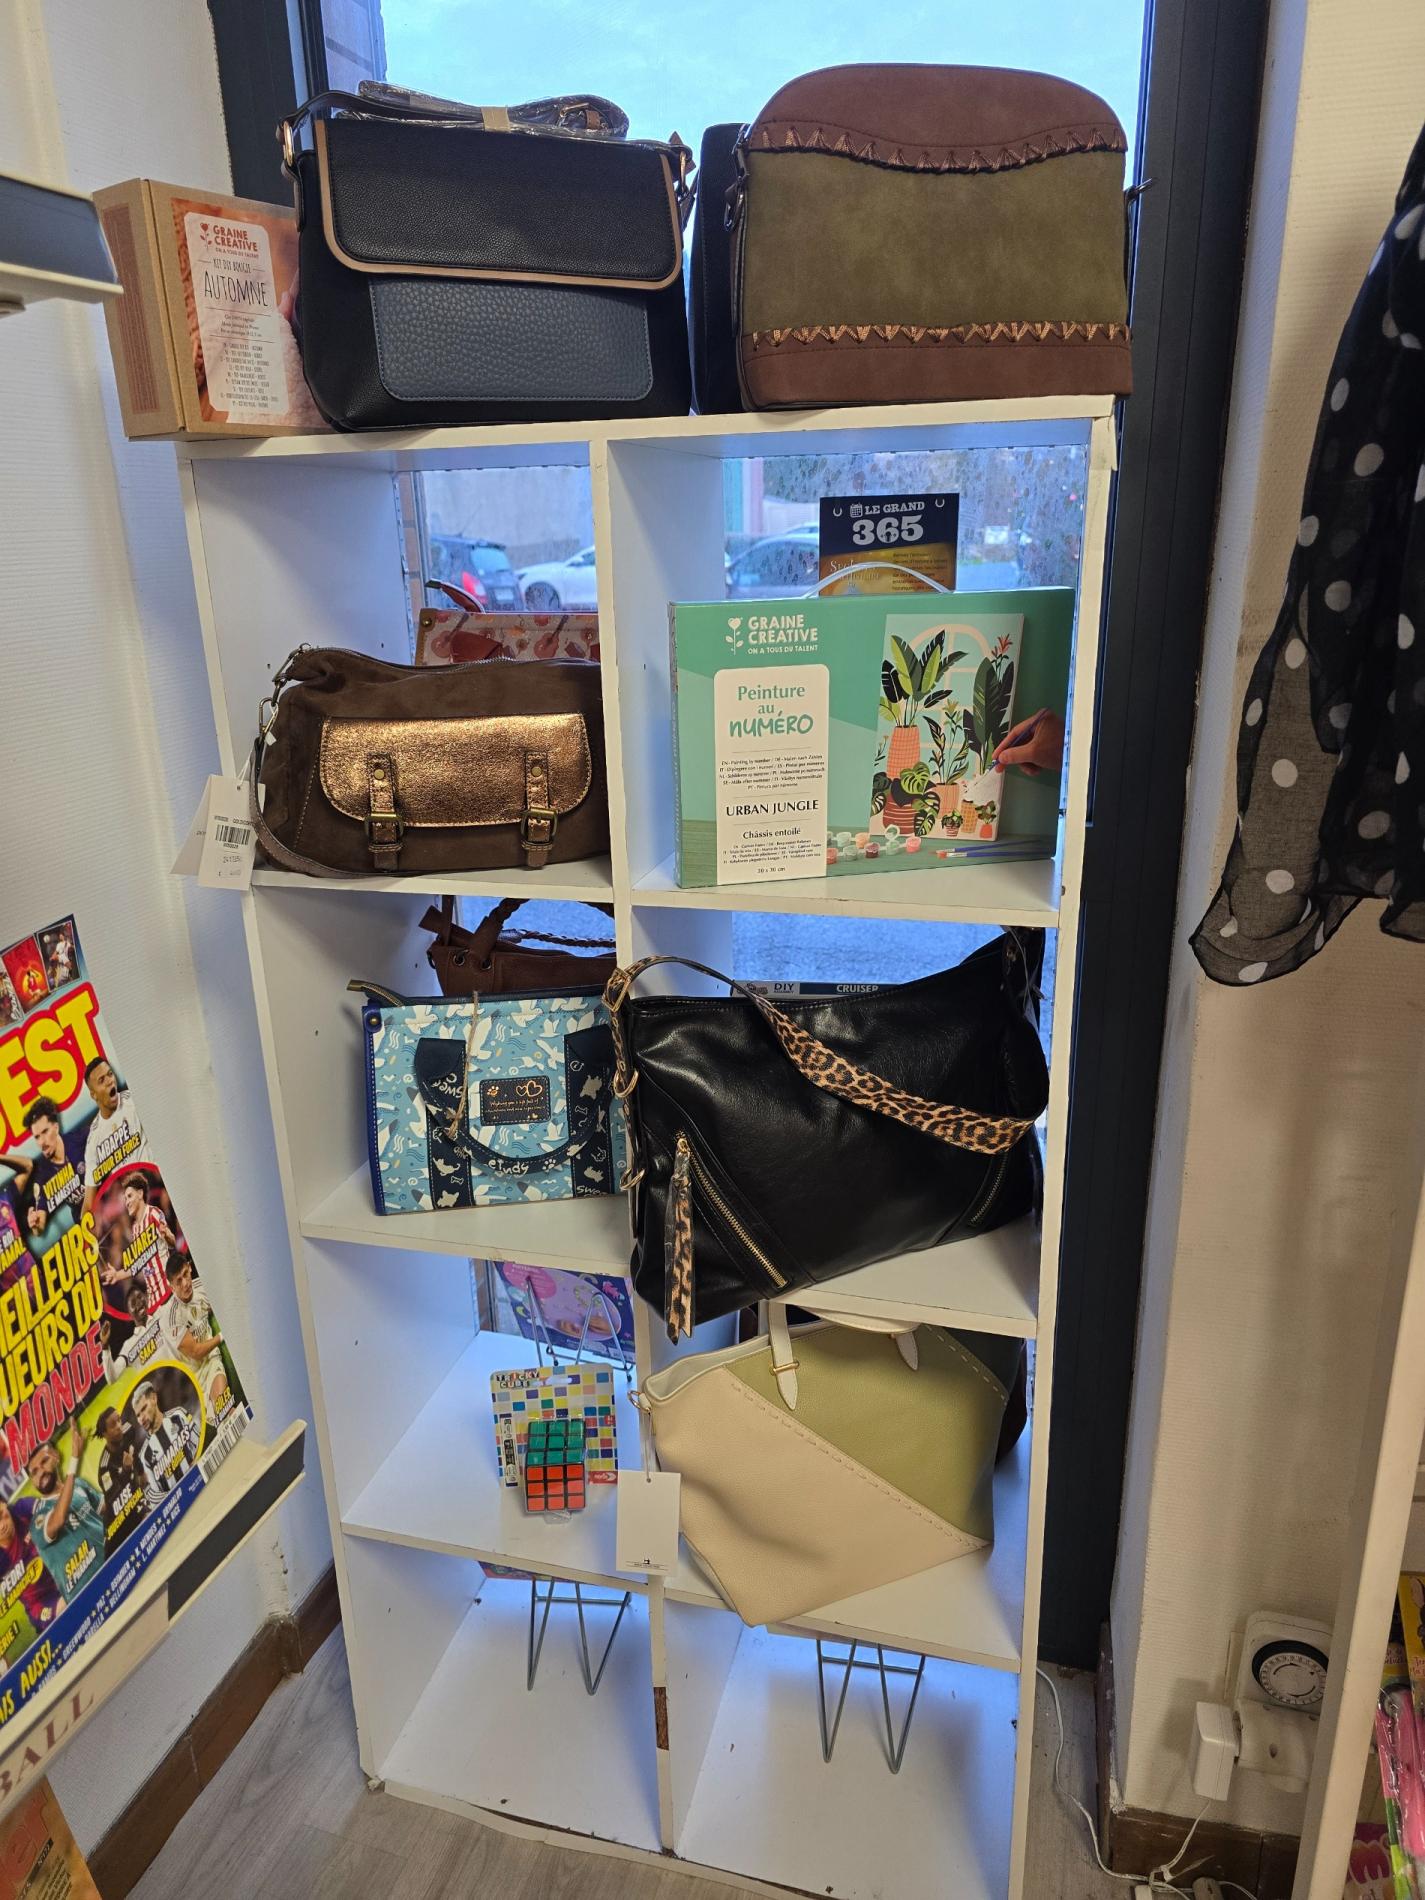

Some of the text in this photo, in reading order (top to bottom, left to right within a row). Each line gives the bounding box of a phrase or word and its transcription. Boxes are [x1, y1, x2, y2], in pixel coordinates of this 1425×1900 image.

[213, 225, 249, 240] GRAINE
[214, 235, 258, 252] CREATIVE
[204, 270, 268, 307] AUTOMNE
[865, 501, 926, 515] LE GRAND
[852, 514, 925, 546] 365
[747, 614, 805, 630] GRAINE
[747, 628, 819, 645] CREATIVE
[747, 647, 758, 655] ON
[767, 646, 783, 654] TOUS
[784, 645, 794, 653] DU
[795, 644, 818, 653] TALENT
[738, 684, 806, 701] Peinture
[758, 704, 775, 714] au
[726, 799, 819, 816] URBAN JUNGLE
[742, 827, 801, 840] Châssis entoilé
[773, 983, 879, 993] DIY CRUISER
[0, 990, 99, 1150] EST
[43, 1162, 75, 1200] VITINHA
[46, 1196, 56, 1213] LE
[54, 1174, 81, 1207] MAESTRO
[0, 1236, 27, 1275] AMAL
[122, 1222, 158, 1271] ALVAREZ
[0, 1265, 103, 1420] UEURS DU
[139, 1337, 157, 1366] SAKA
[496, 1370, 540, 1382] TRICKY
[500, 1380, 530, 1389] CUBE
[4, 1320, 105, 1476] MONDE
[113, 1483, 132, 1516] OLISE
[170, 1503, 181, 1521] RICE
[107, 1510, 126, 1541] JOUEUR
[65, 1539, 89, 1579] SALAH
[0, 1559, 25, 1599] PEDRI
[66, 1578, 74, 1593] LE
[21, 1639, 62, 1699] AUSSI...
